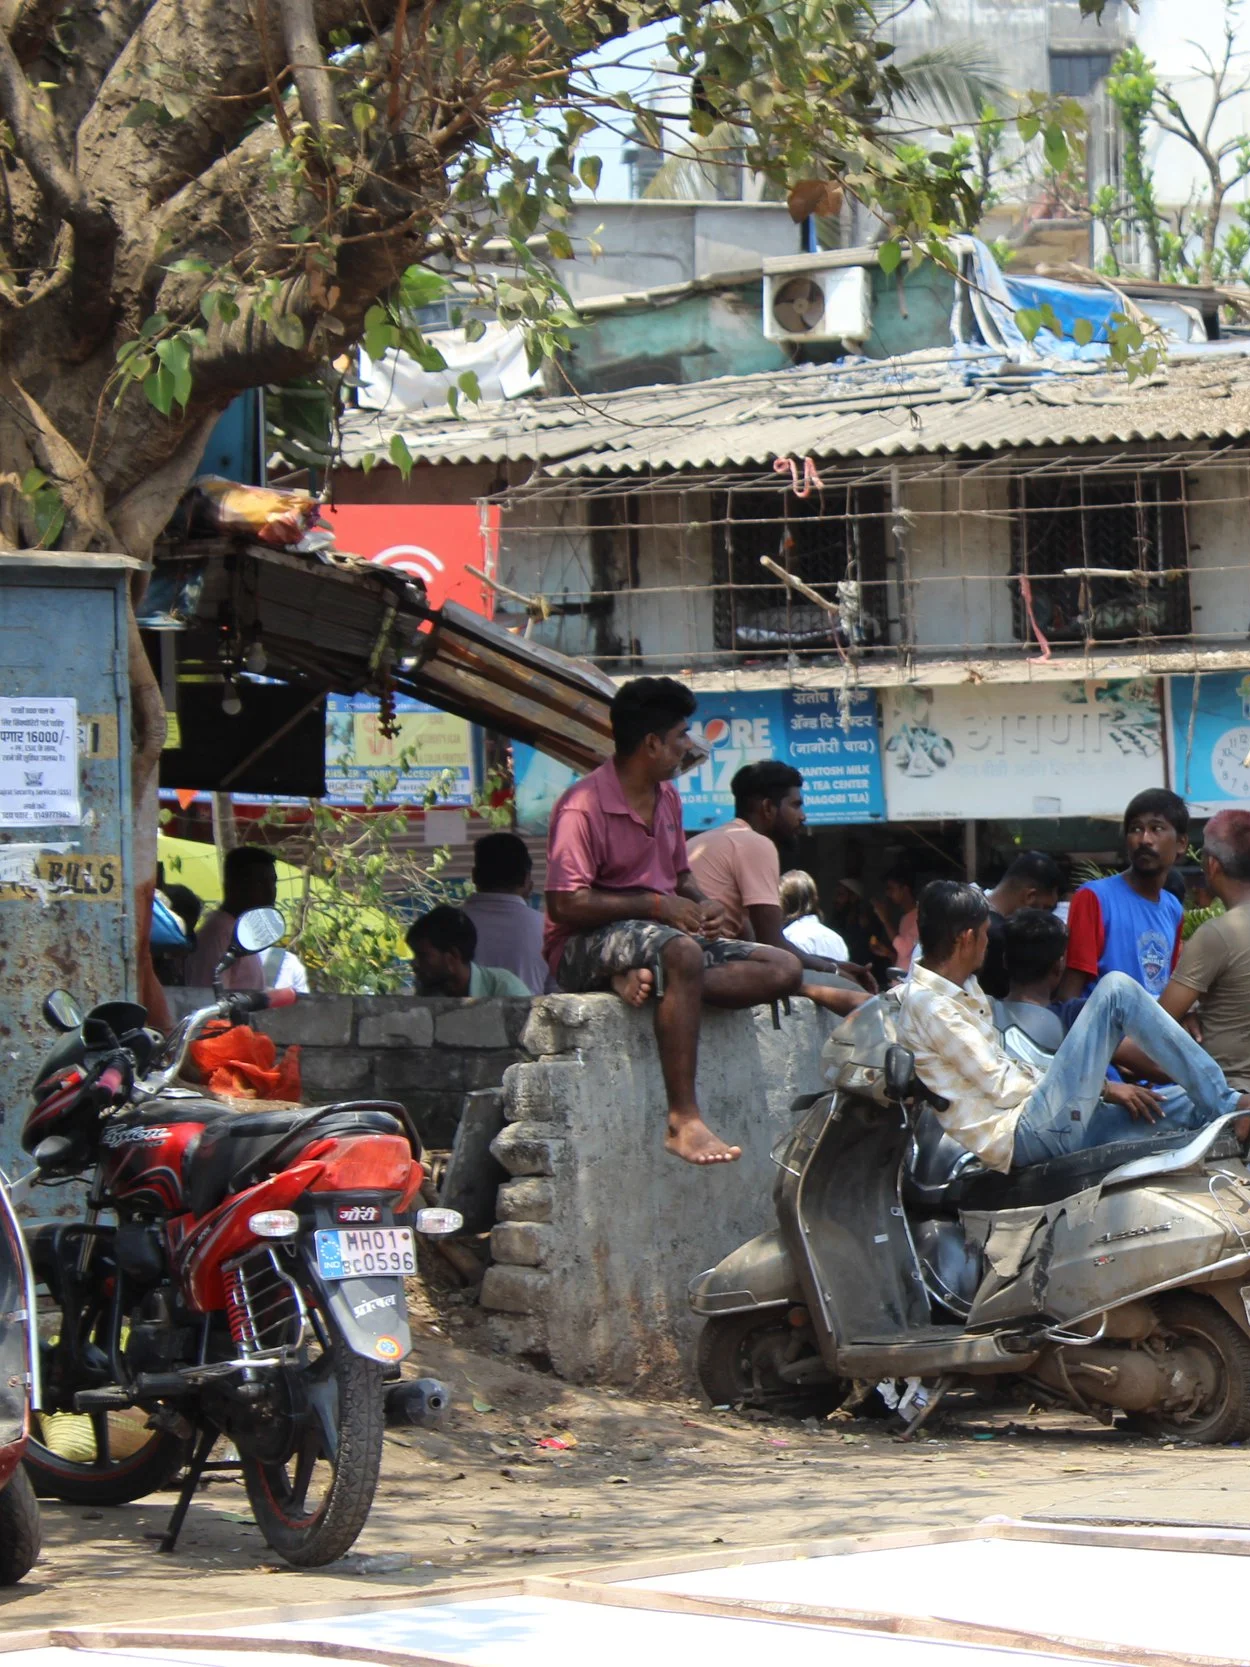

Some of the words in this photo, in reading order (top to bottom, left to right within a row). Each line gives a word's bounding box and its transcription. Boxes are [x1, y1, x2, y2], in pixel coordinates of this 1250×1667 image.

[26, 730, 71, 746] 16000/-
[812, 780, 831, 790] TEA
[832, 779, 869, 789] CENTER
[345, 1230, 398, 1252] MH01
[324, 1261, 341, 1269] IND
